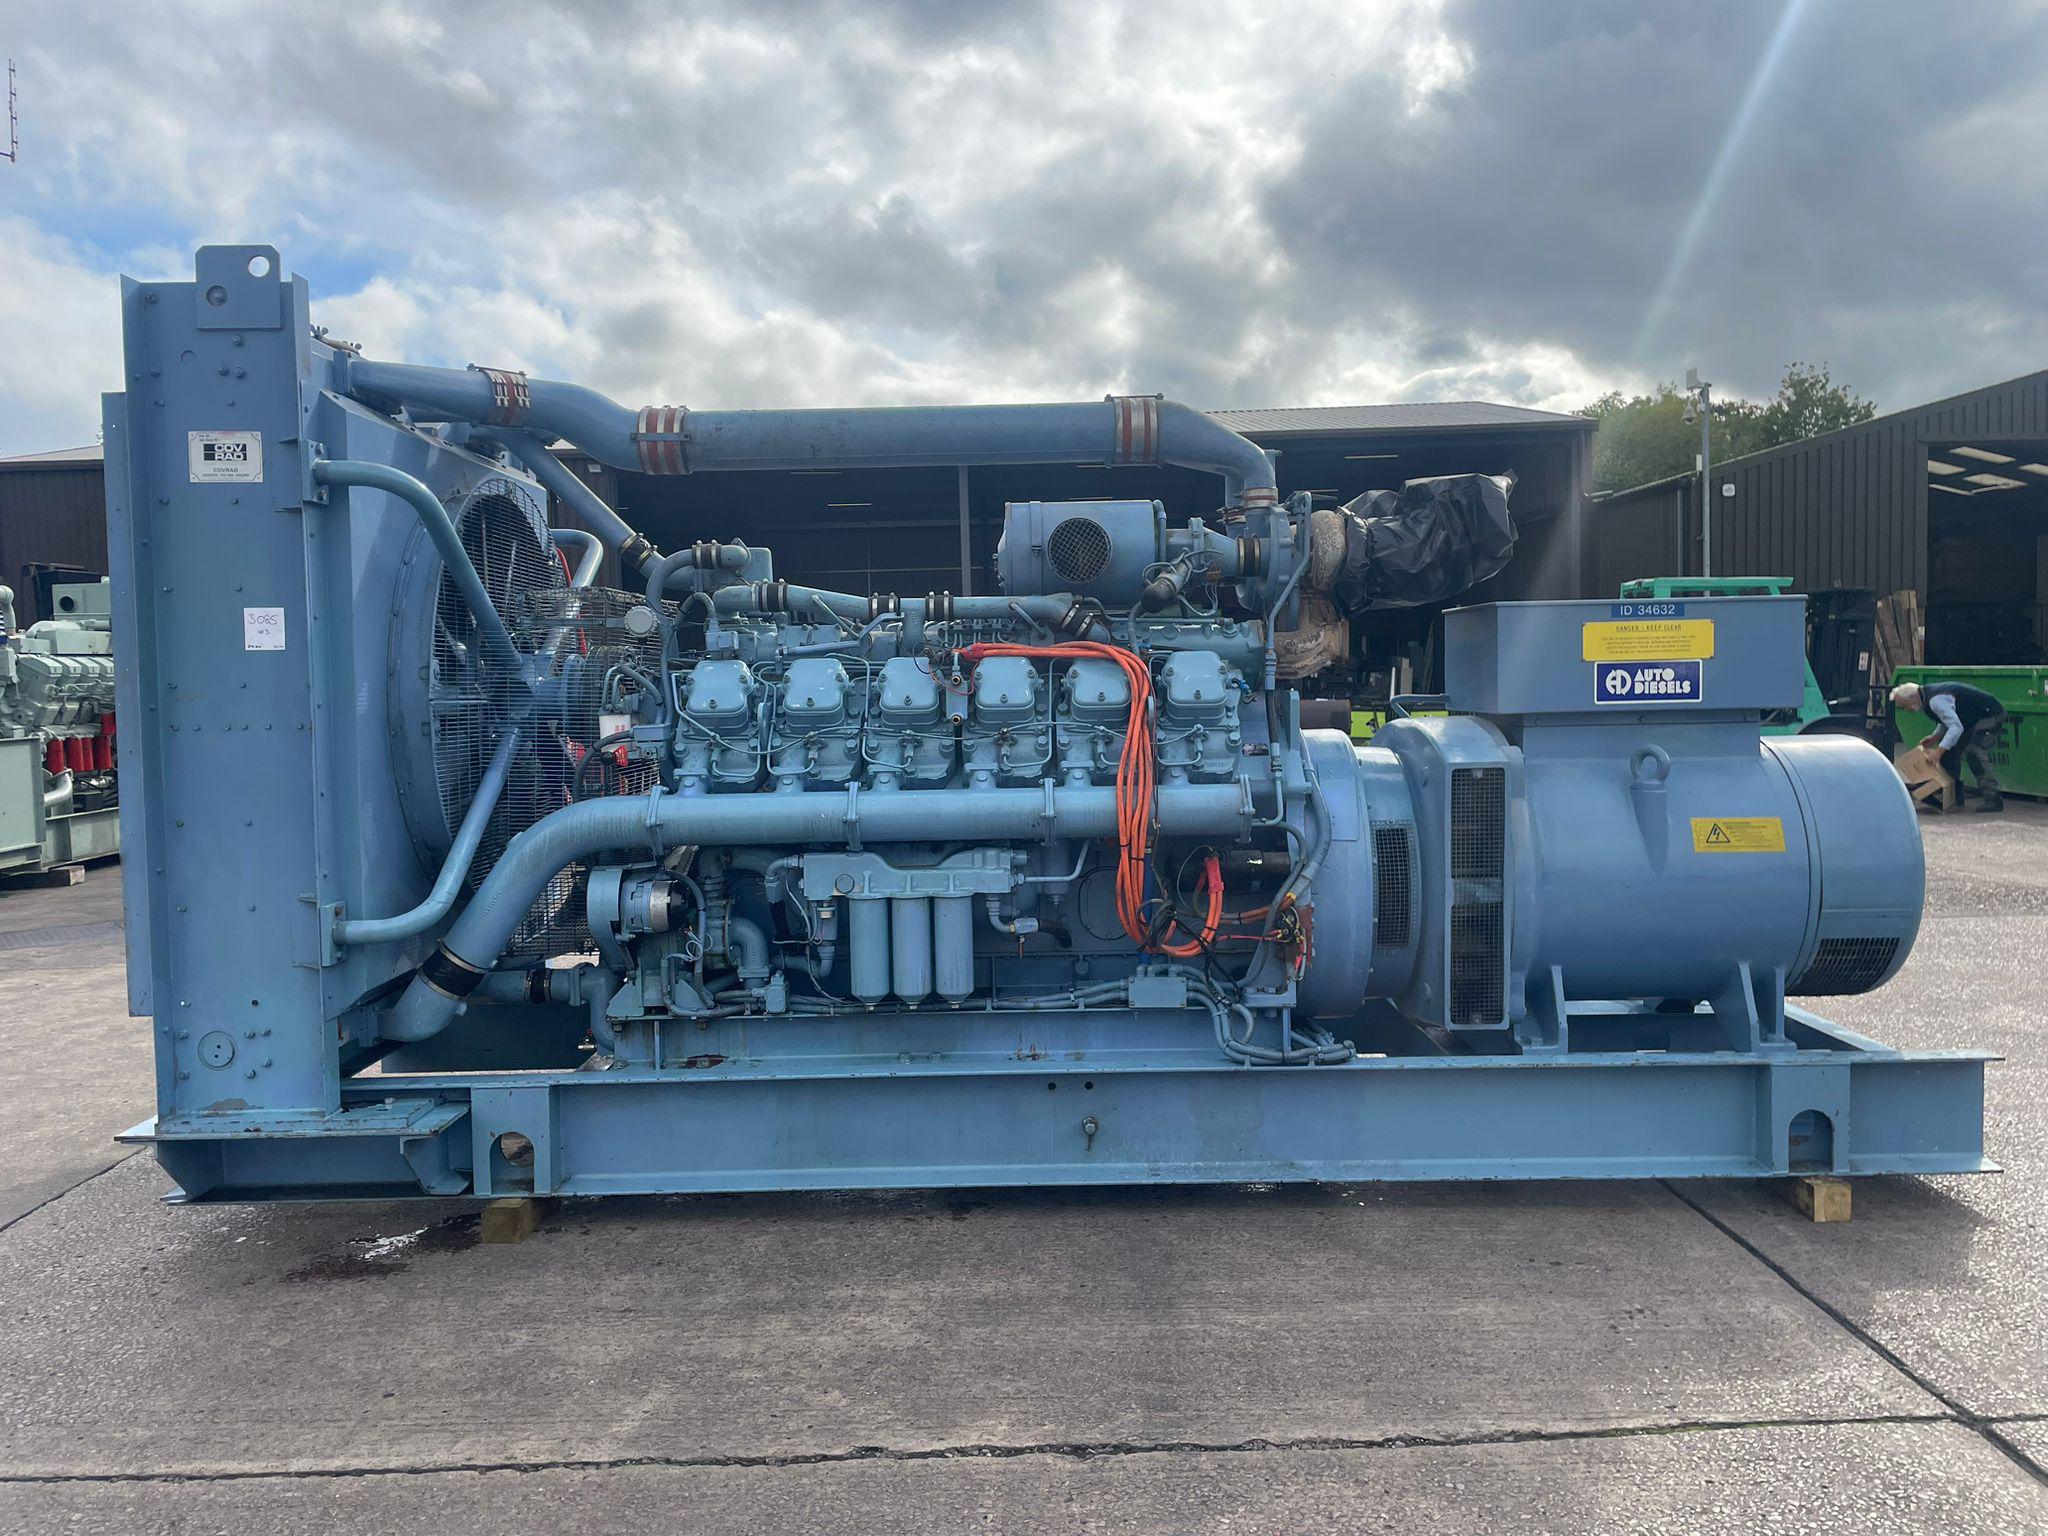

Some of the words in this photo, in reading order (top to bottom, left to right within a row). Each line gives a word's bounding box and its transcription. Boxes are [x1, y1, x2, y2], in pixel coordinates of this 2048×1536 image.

[214, 444, 243, 452] COV
[214, 452, 244, 461] RAD
[1620, 605, 1633, 616] ID
[1637, 604, 1675, 616] 34632
[1633, 667, 1675, 682] AUTO
[1634, 680, 1691, 694] DIESELS
